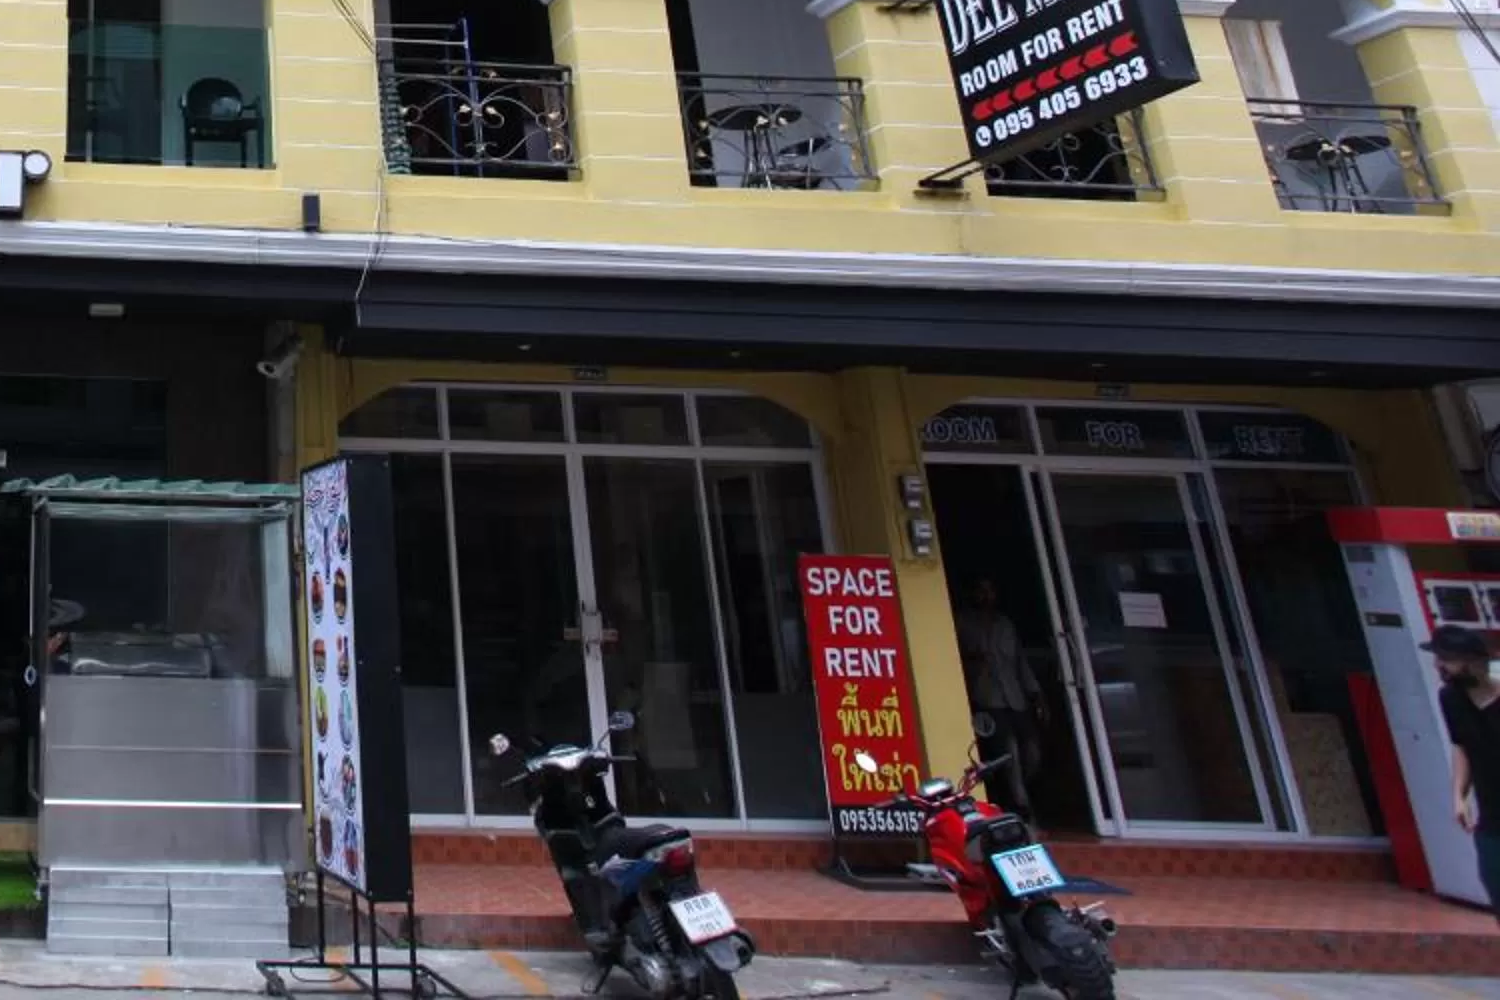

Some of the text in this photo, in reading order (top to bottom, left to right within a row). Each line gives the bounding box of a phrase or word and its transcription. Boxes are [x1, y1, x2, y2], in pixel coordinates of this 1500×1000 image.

[960, 48, 1019, 97] ROOM
[1020, 27, 1064, 67] FOR
[992, 55, 1149, 141] 095 405 6933
[1085, 420, 1145, 449] FOR
[807, 567, 893, 597] SPACE
[828, 605, 882, 635] FOR
[824, 647, 896, 678] RENT
[837, 682, 903, 738] พื้นที่
